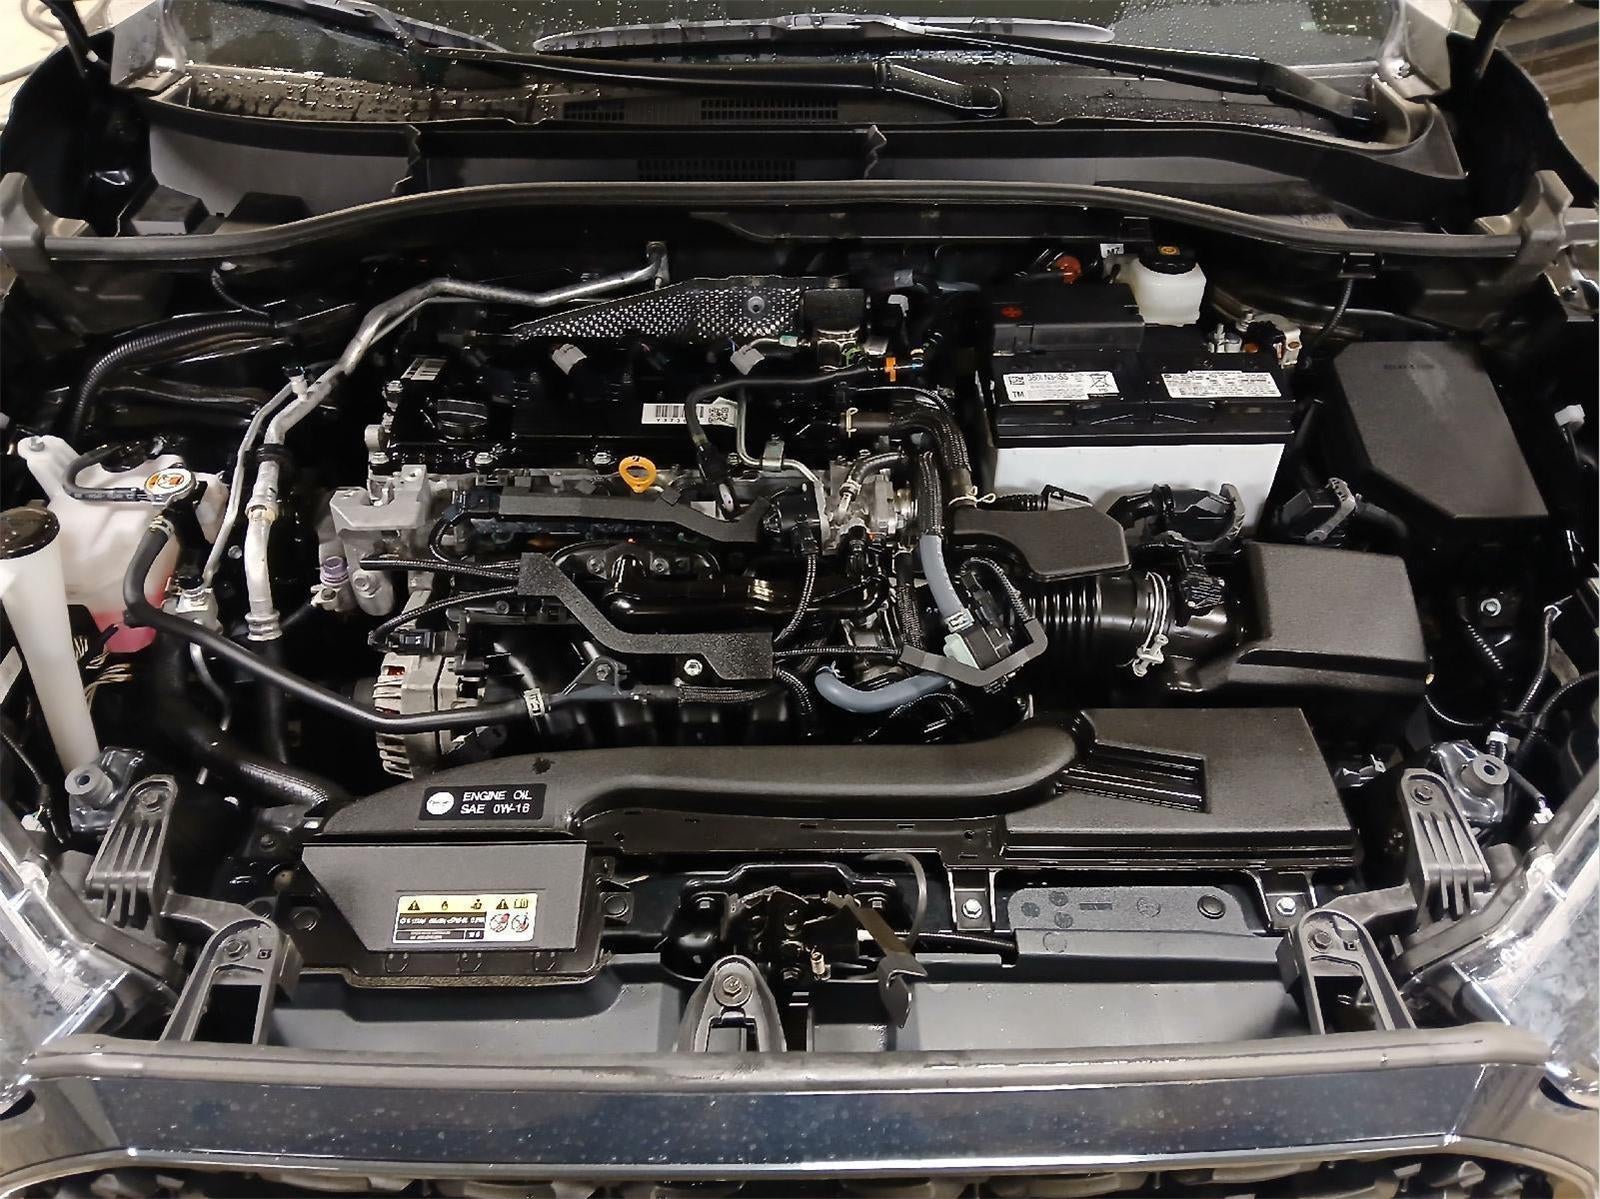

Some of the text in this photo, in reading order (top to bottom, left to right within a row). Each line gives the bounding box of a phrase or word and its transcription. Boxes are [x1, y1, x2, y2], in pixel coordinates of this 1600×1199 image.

[462, 789, 533, 802] ENGINE OIL
[460, 803, 486, 814] SAE
